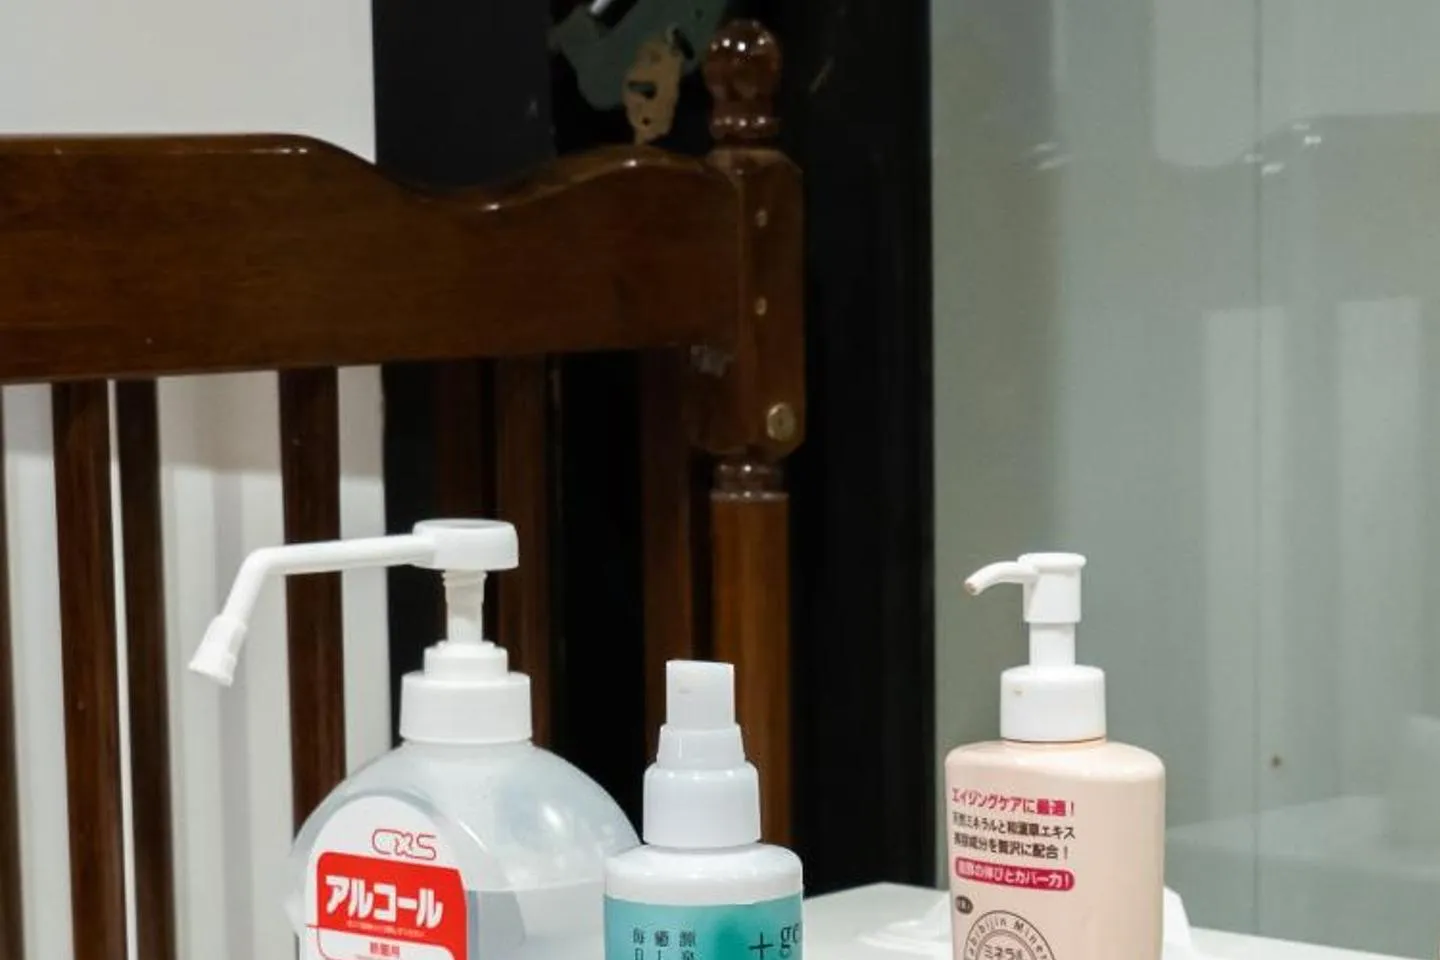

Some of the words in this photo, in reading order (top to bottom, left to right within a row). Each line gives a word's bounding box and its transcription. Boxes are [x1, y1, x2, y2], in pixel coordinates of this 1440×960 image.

[325, 875, 444, 929] アルコール
